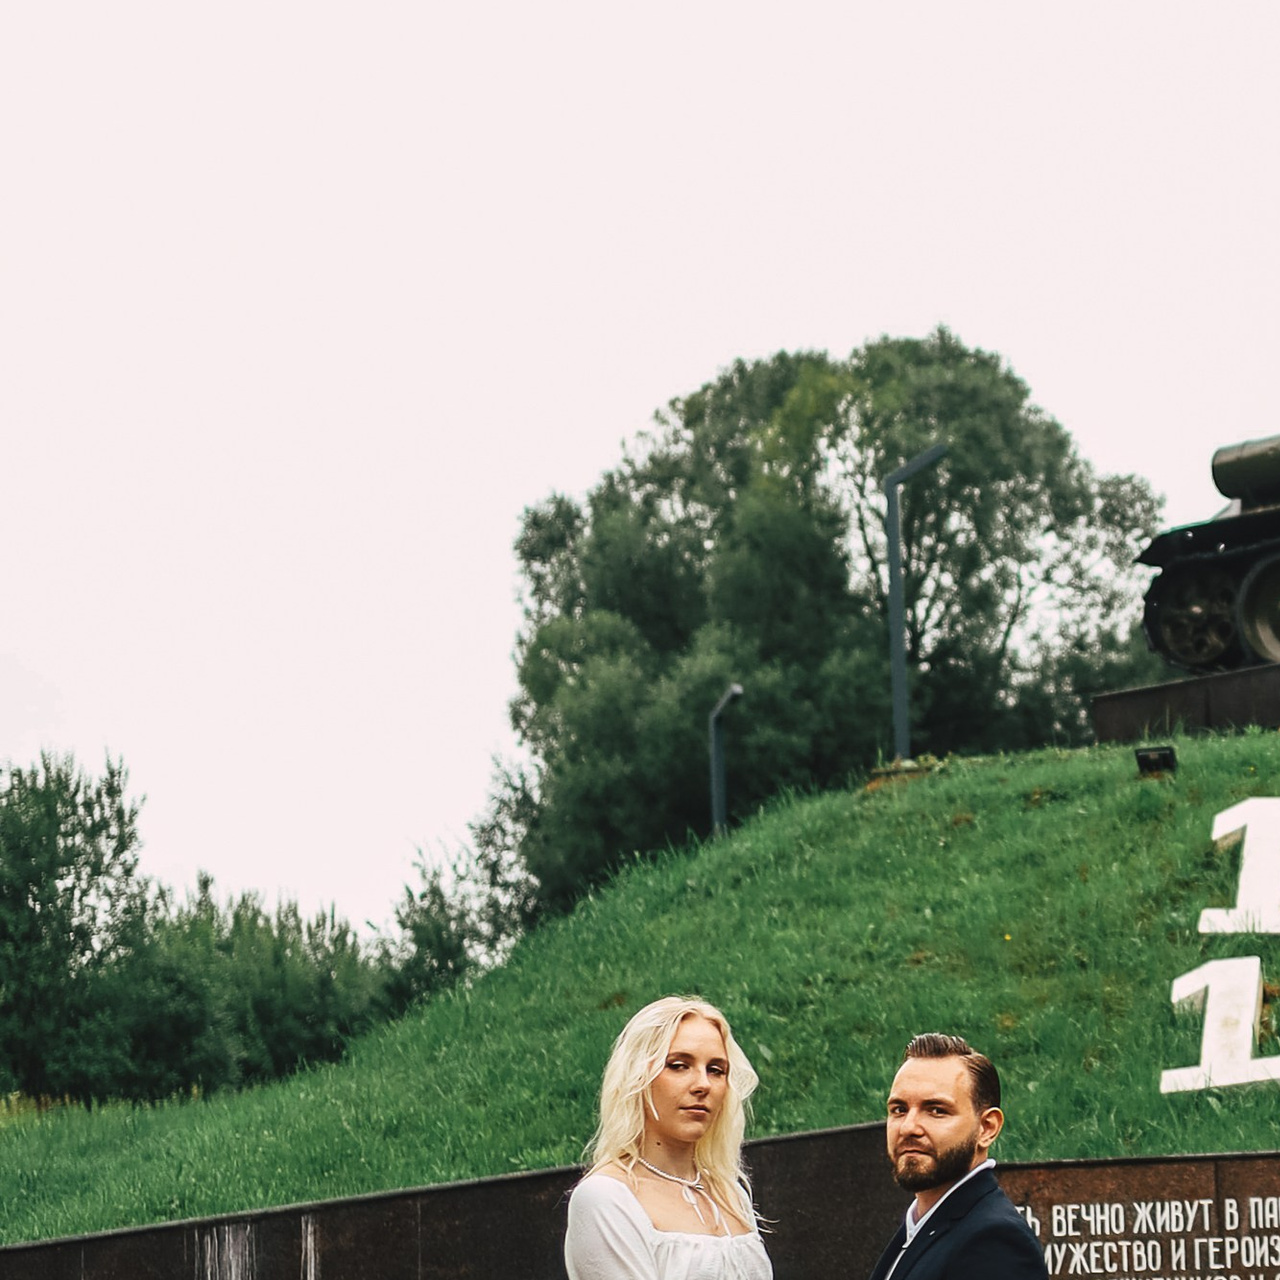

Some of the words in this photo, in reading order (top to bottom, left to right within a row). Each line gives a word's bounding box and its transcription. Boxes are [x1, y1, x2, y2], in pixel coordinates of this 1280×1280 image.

[1052, 1202, 1125, 1237] ВЕЧНО
[1133, 1199, 1213, 1234] ЖИВУТ
[1224, 1198, 1239, 1231] В
[1170, 1238, 1186, 1271] И
